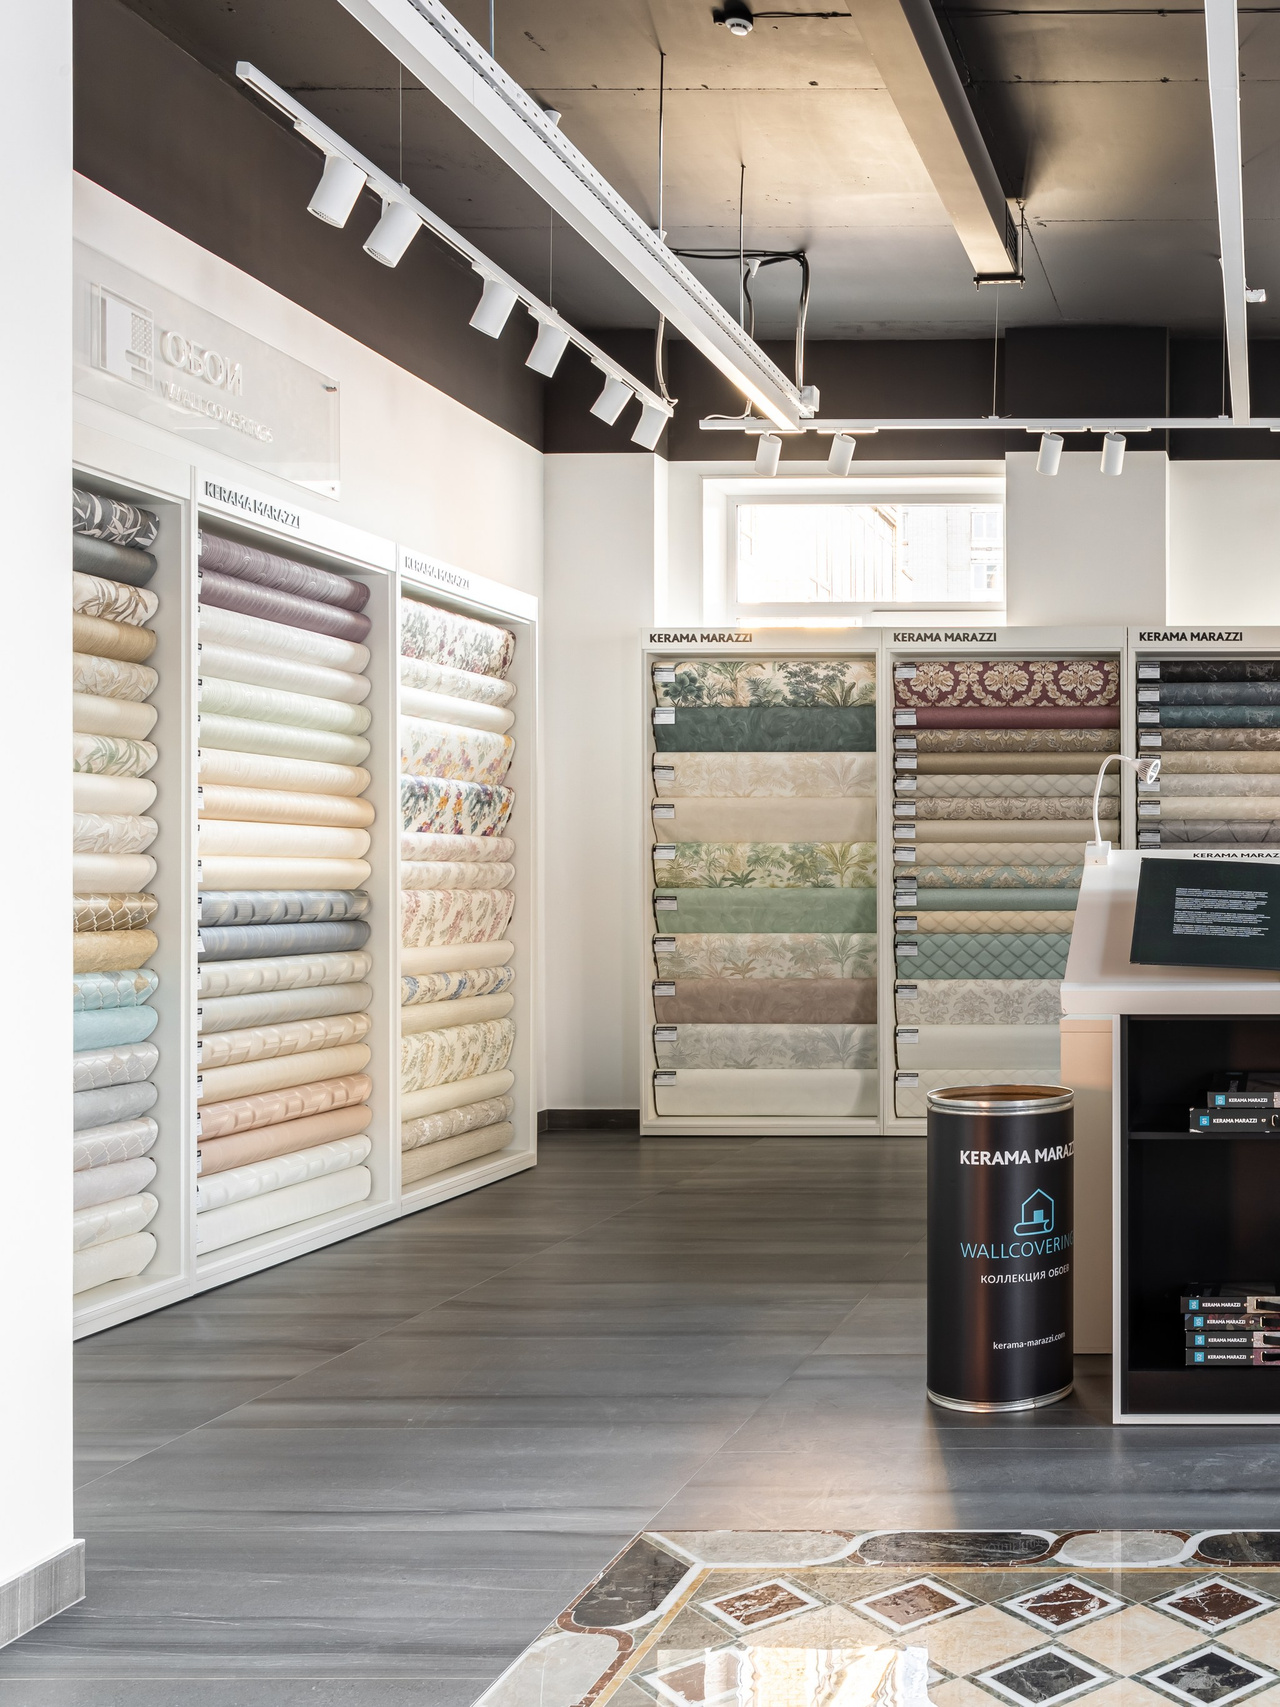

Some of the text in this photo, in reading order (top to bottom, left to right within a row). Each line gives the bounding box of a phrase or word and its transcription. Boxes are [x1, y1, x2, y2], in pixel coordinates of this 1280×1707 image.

[161, 330, 243, 396] ОБОИ
[204, 481, 300, 529] KERAMA MARAZZI
[405, 556, 438, 579] KERAMA
[650, 633, 752, 643] KERAMA MARAZZI
[893, 633, 996, 643] KERAMA MARAZZI
[1139, 632, 1243, 642] KERAMA MARAZZI
[960, 1148, 1032, 1166] KERAMA
[960, 1230, 1074, 1259] WALLCOVERING
[980, 1263, 1070, 1284] КОЛЛЕКЦИЯ ОБОЕВ
[992, 1330, 1066, 1350] kerama-marazzi.com
